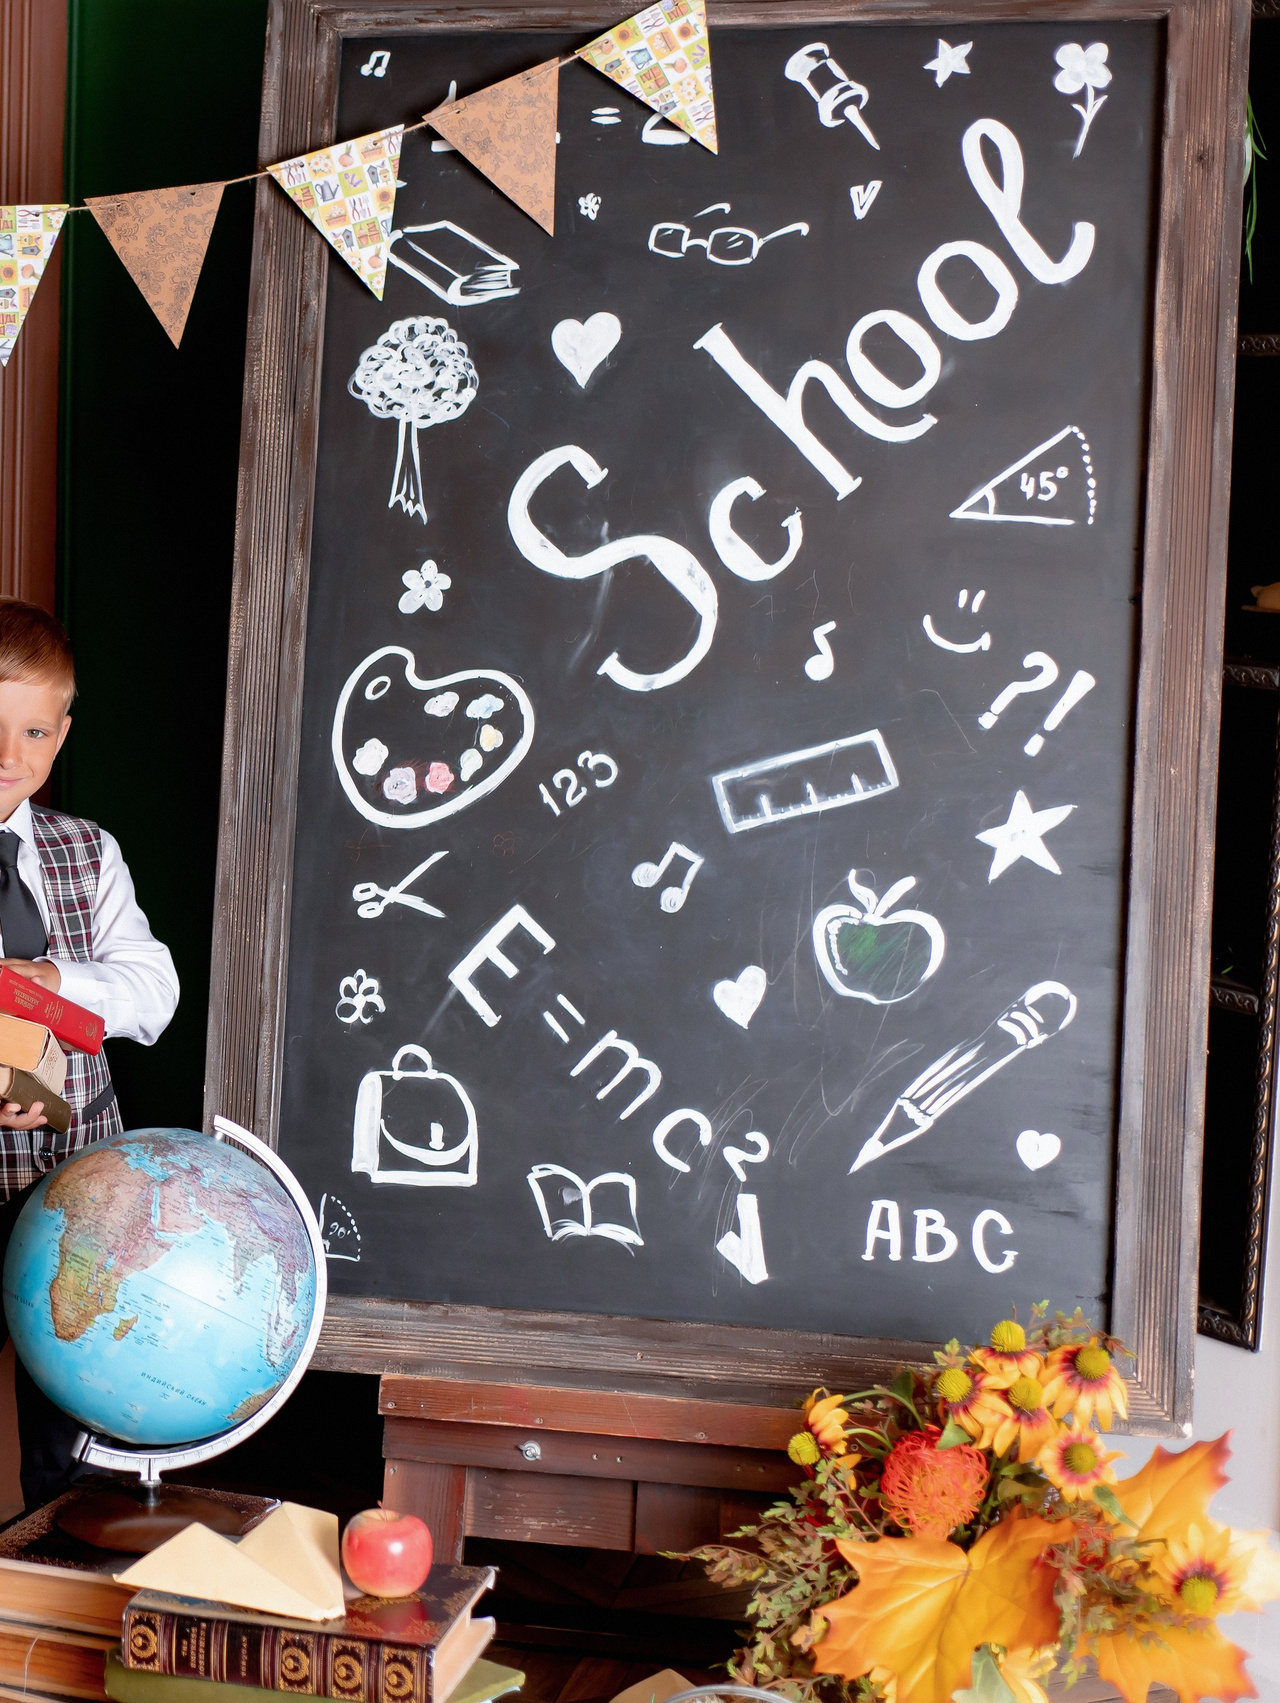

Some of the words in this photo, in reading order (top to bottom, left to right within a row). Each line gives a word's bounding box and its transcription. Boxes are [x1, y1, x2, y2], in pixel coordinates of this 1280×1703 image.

[506, 118, 1095, 692] School
[539, 750, 620, 817] 123
[141, 1372, 185, 1395] ИНДИЙСКИЙ
[186, 1393, 207, 1406] ОКЕАН
